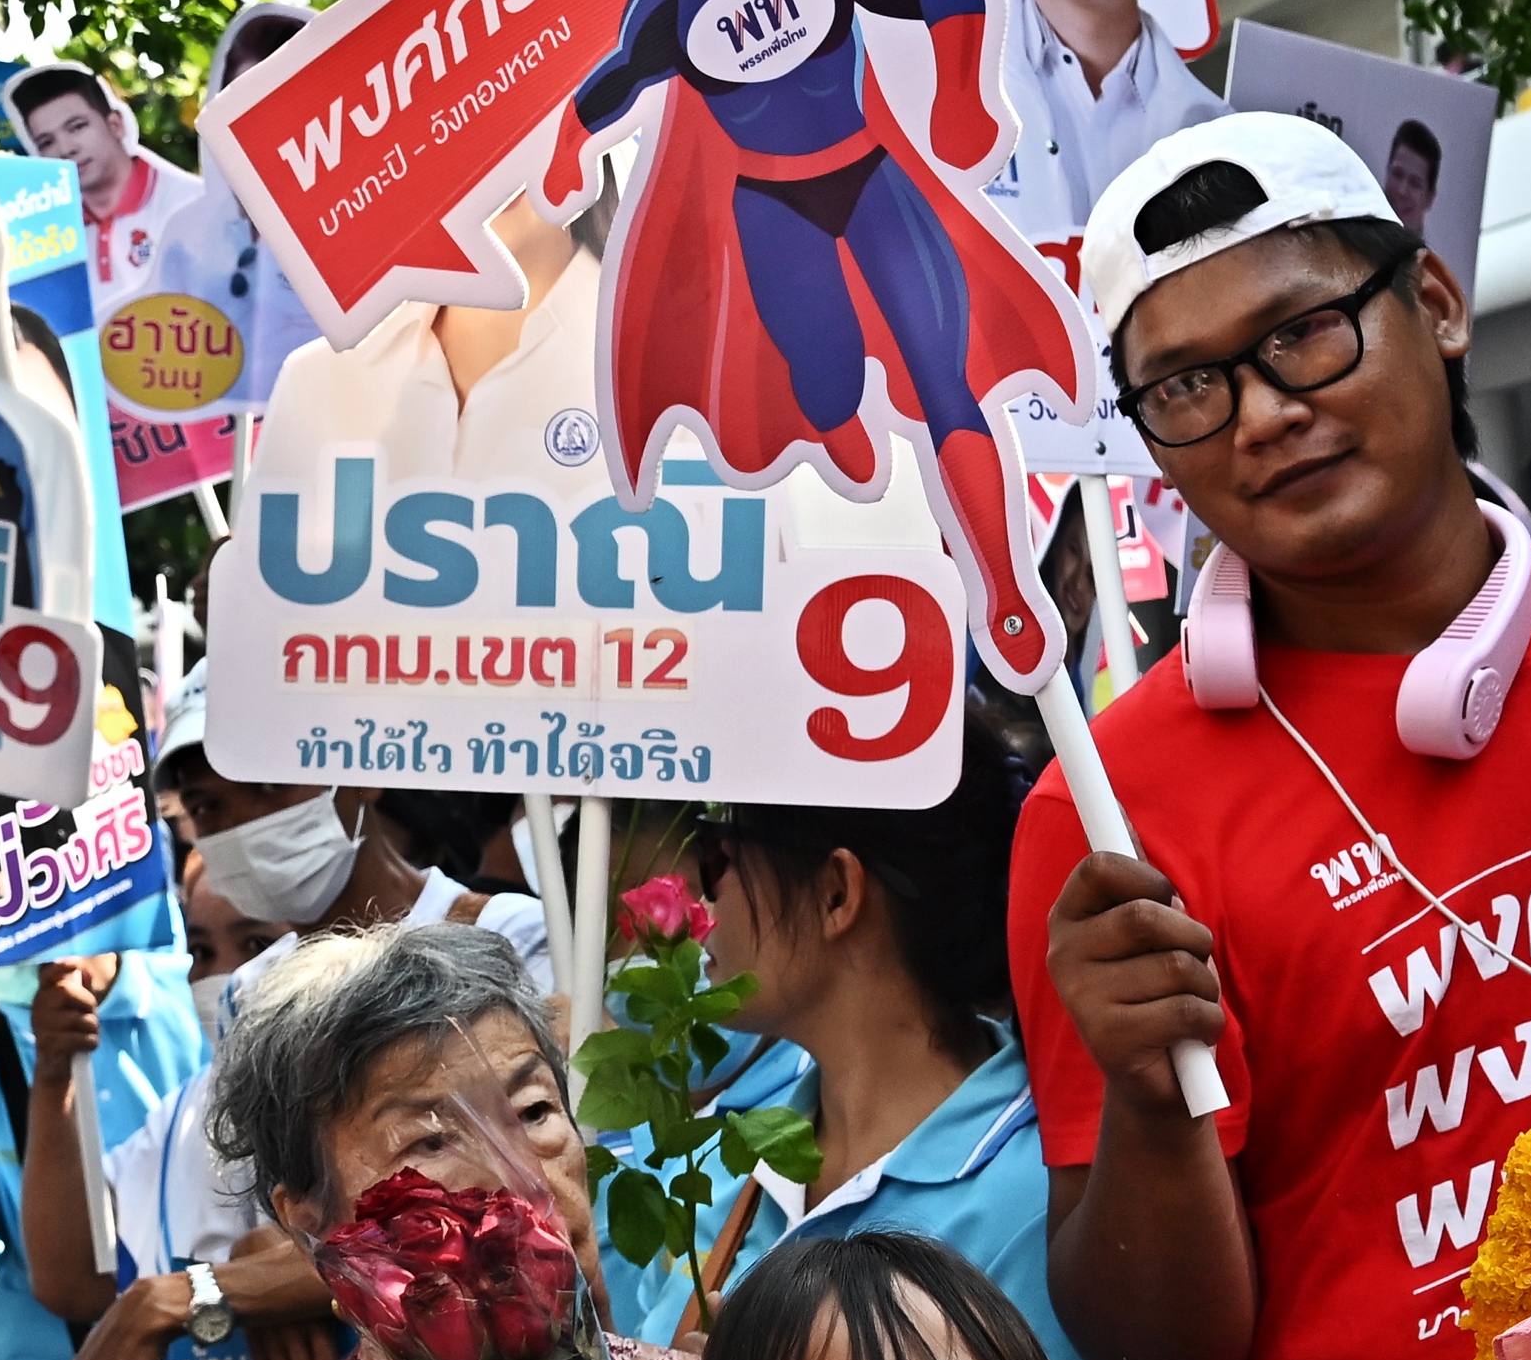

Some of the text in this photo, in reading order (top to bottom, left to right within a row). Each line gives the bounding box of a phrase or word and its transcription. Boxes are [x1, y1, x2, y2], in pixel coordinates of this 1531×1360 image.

[739, 26, 808, 73] พรรคเพื่อไทย
[317, 147, 410, 239] บางกะปิ
[431, 13, 573, 151] วังทองหลาง
[108, 306, 234, 357] ฮาซัน
[281, 628, 689, 690] กทม.เขต 12
[795, 574, 955, 763] 9
[295, 713, 712, 784] ทำได้ไว ทำได้จริง
